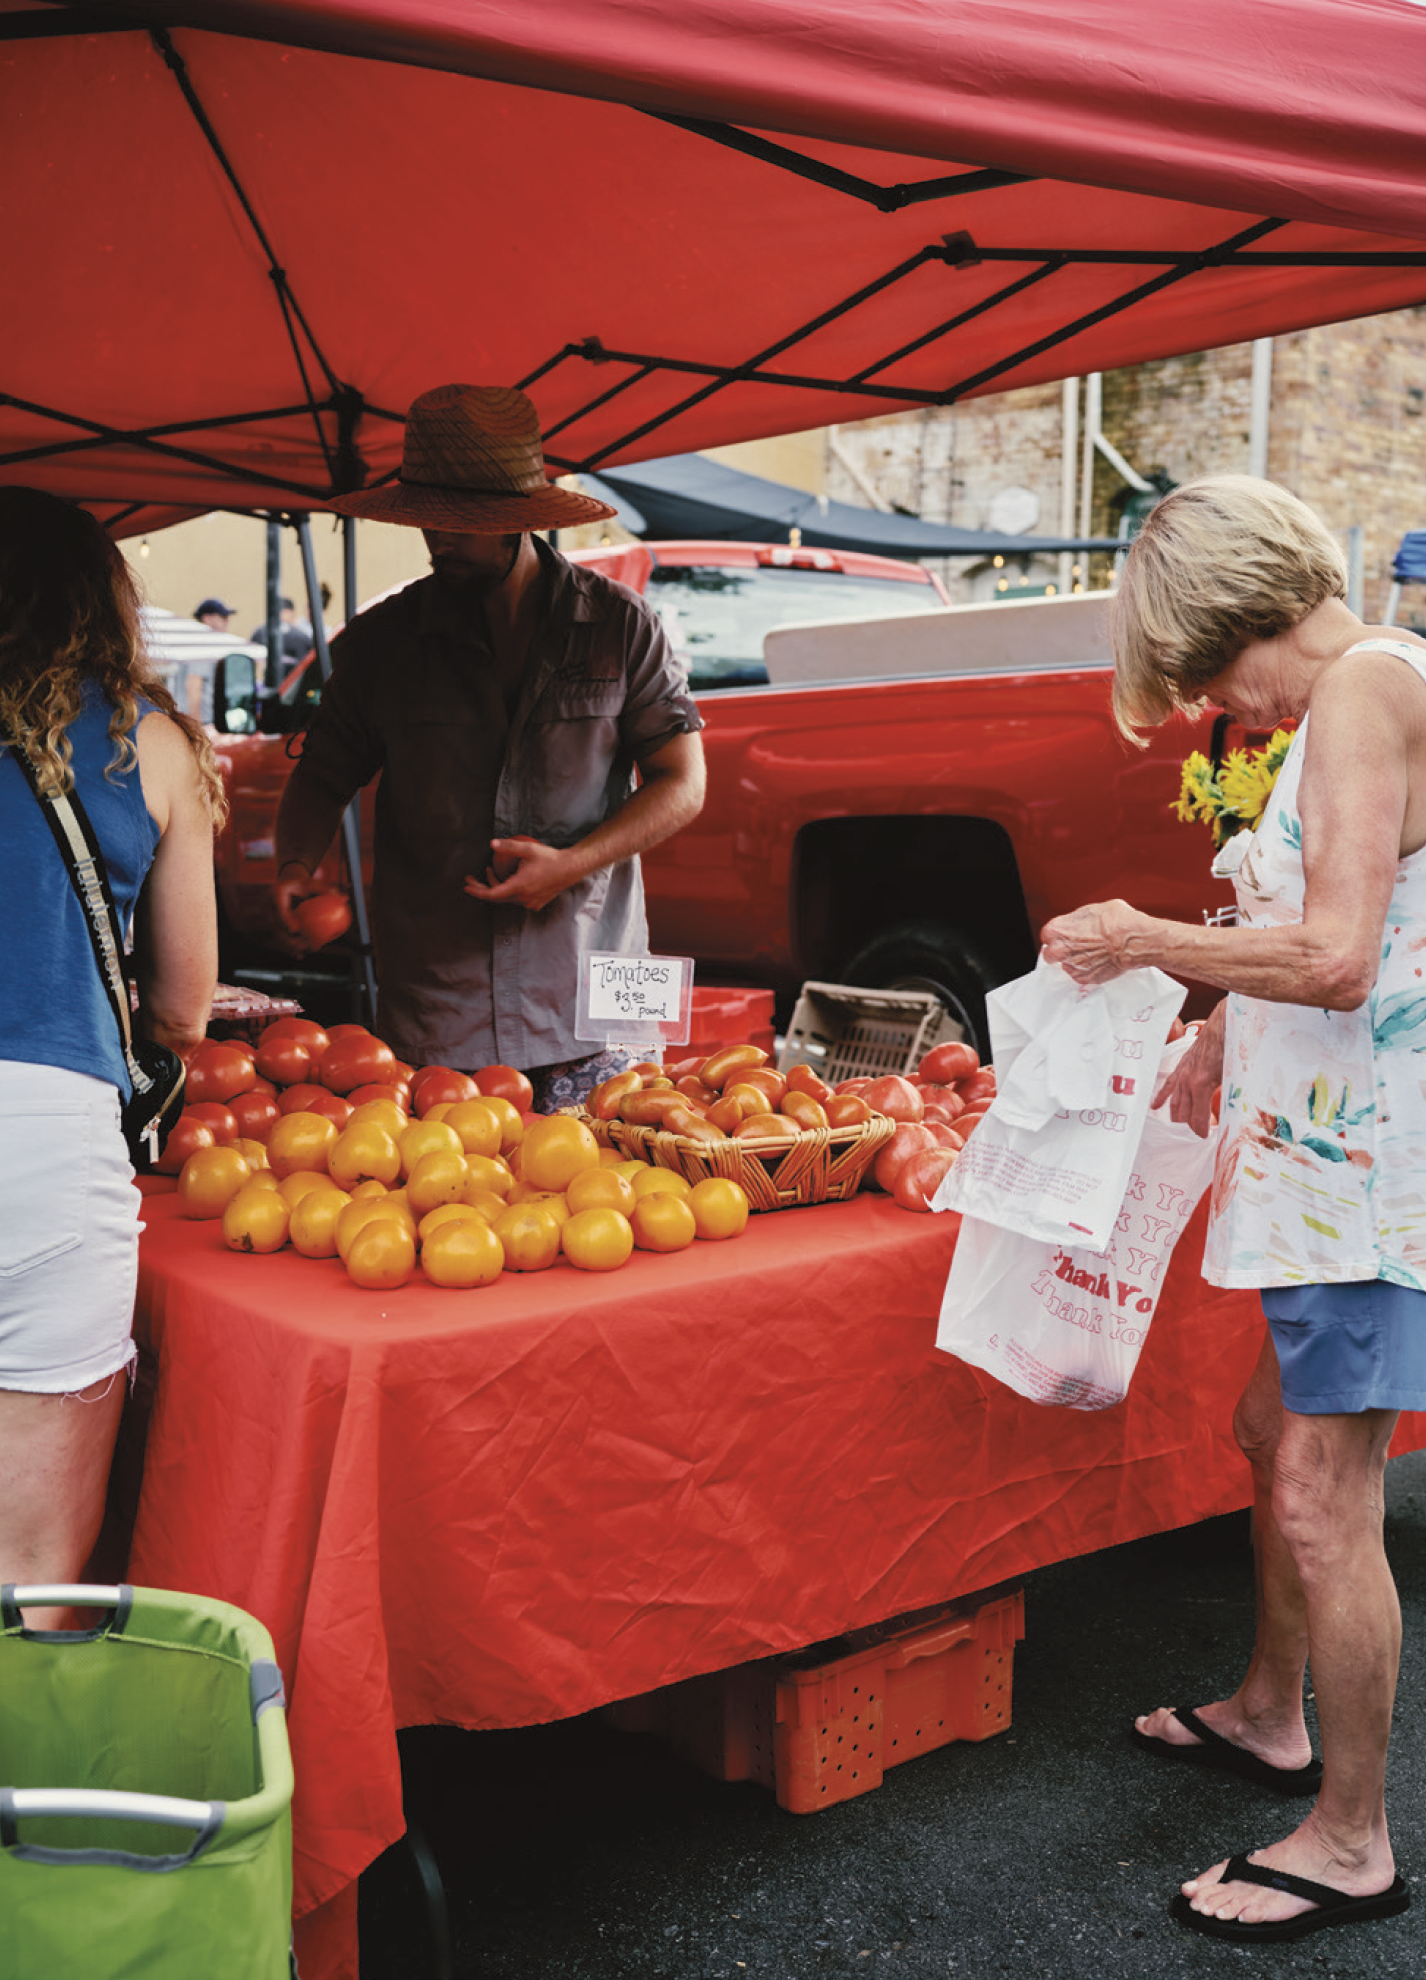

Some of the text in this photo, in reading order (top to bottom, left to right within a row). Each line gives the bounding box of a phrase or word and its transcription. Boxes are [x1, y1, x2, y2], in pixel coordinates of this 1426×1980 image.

[73, 857, 120, 991] lululemon
[592, 960, 670, 989] Tomatoes
[639, 1002, 667, 1019] pound
[1054, 1108, 1127, 1132] ou
[1117, 1280, 1153, 1313] Yo
